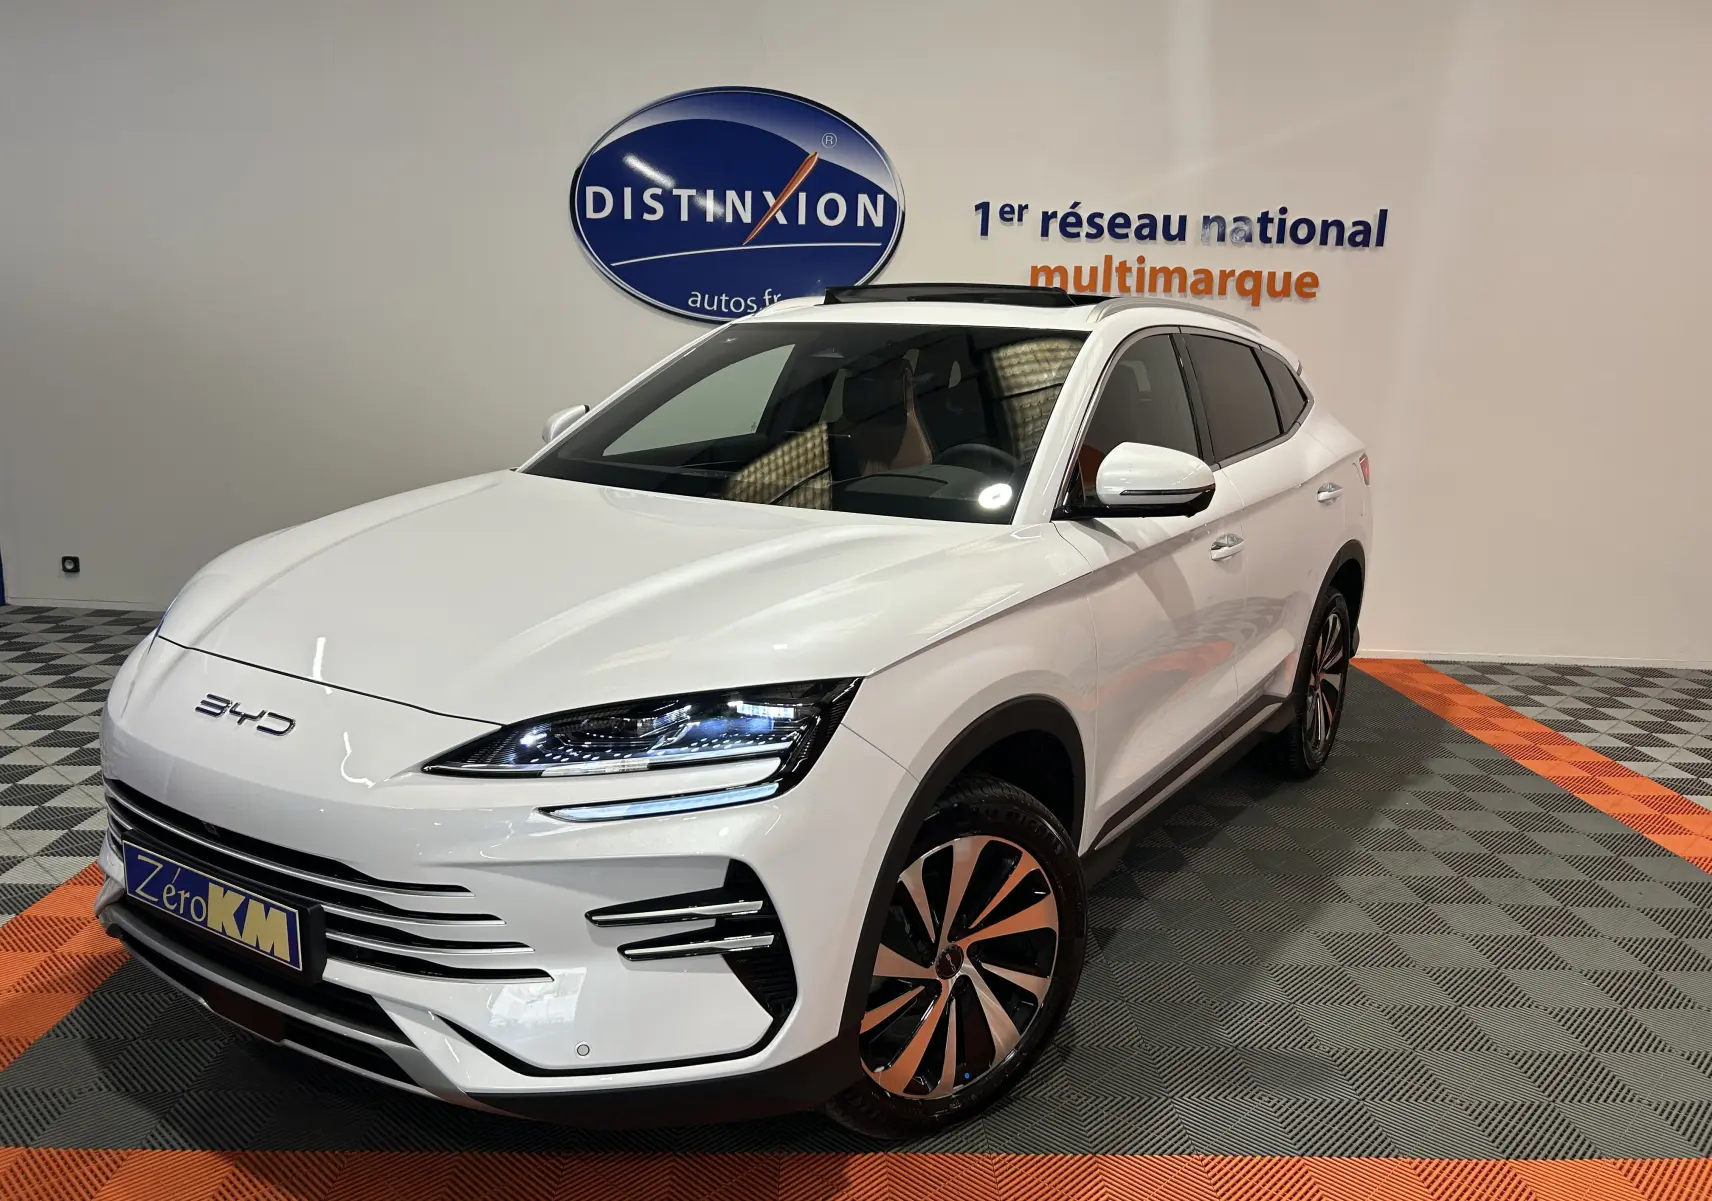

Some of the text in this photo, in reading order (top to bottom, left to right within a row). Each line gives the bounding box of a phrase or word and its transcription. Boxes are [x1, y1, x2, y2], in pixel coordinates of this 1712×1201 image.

[584, 184, 886, 229] DISTINXION
[974, 201, 1389, 247] 1er réseau national
[1030, 255, 1320, 306] multimarque
[195, 693, 297, 737] BYD
